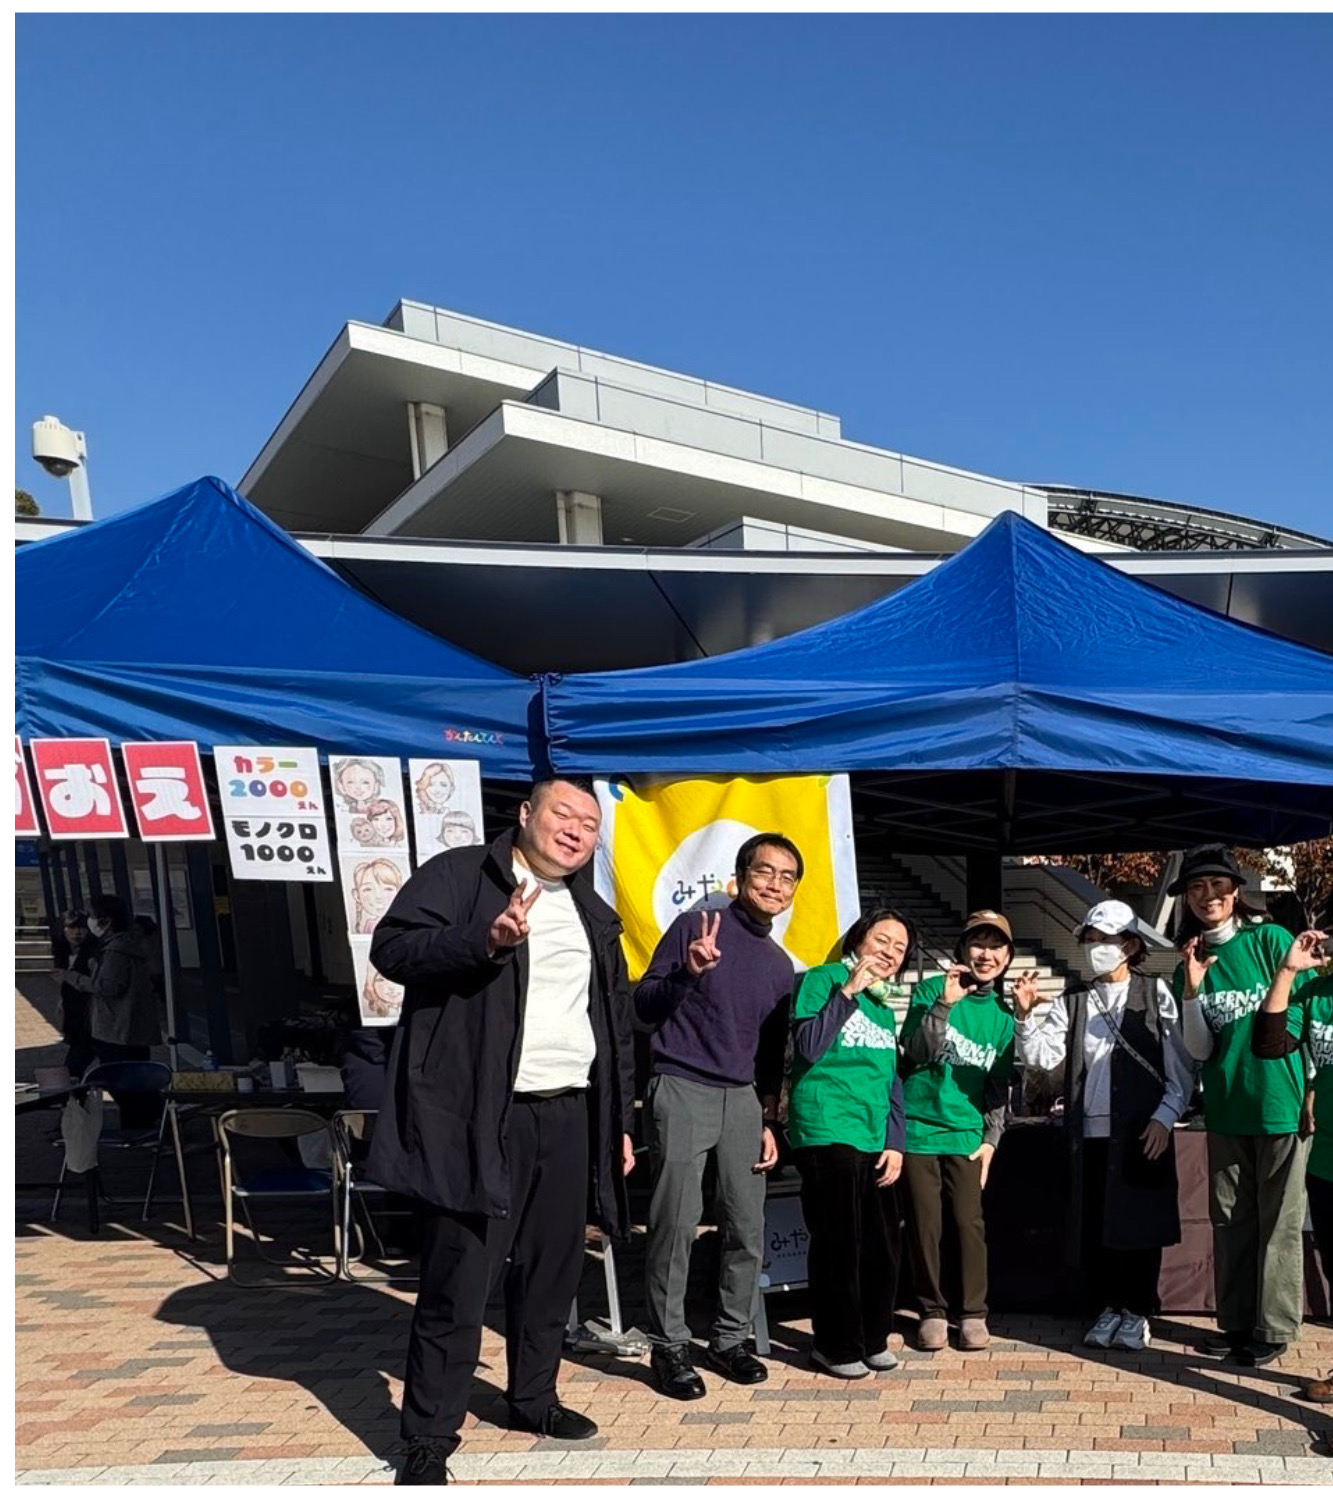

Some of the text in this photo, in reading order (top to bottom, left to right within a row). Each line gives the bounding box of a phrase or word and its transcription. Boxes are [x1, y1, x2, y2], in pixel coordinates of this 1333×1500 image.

[233, 755, 299, 774] カラー
[228, 779, 309, 799] 2000
[297, 801, 320, 811] えん
[231, 820, 319, 841] モノクロ
[239, 843, 315, 864] 1000
[305, 866, 328, 876] えん
[672, 873, 737, 905] みや
